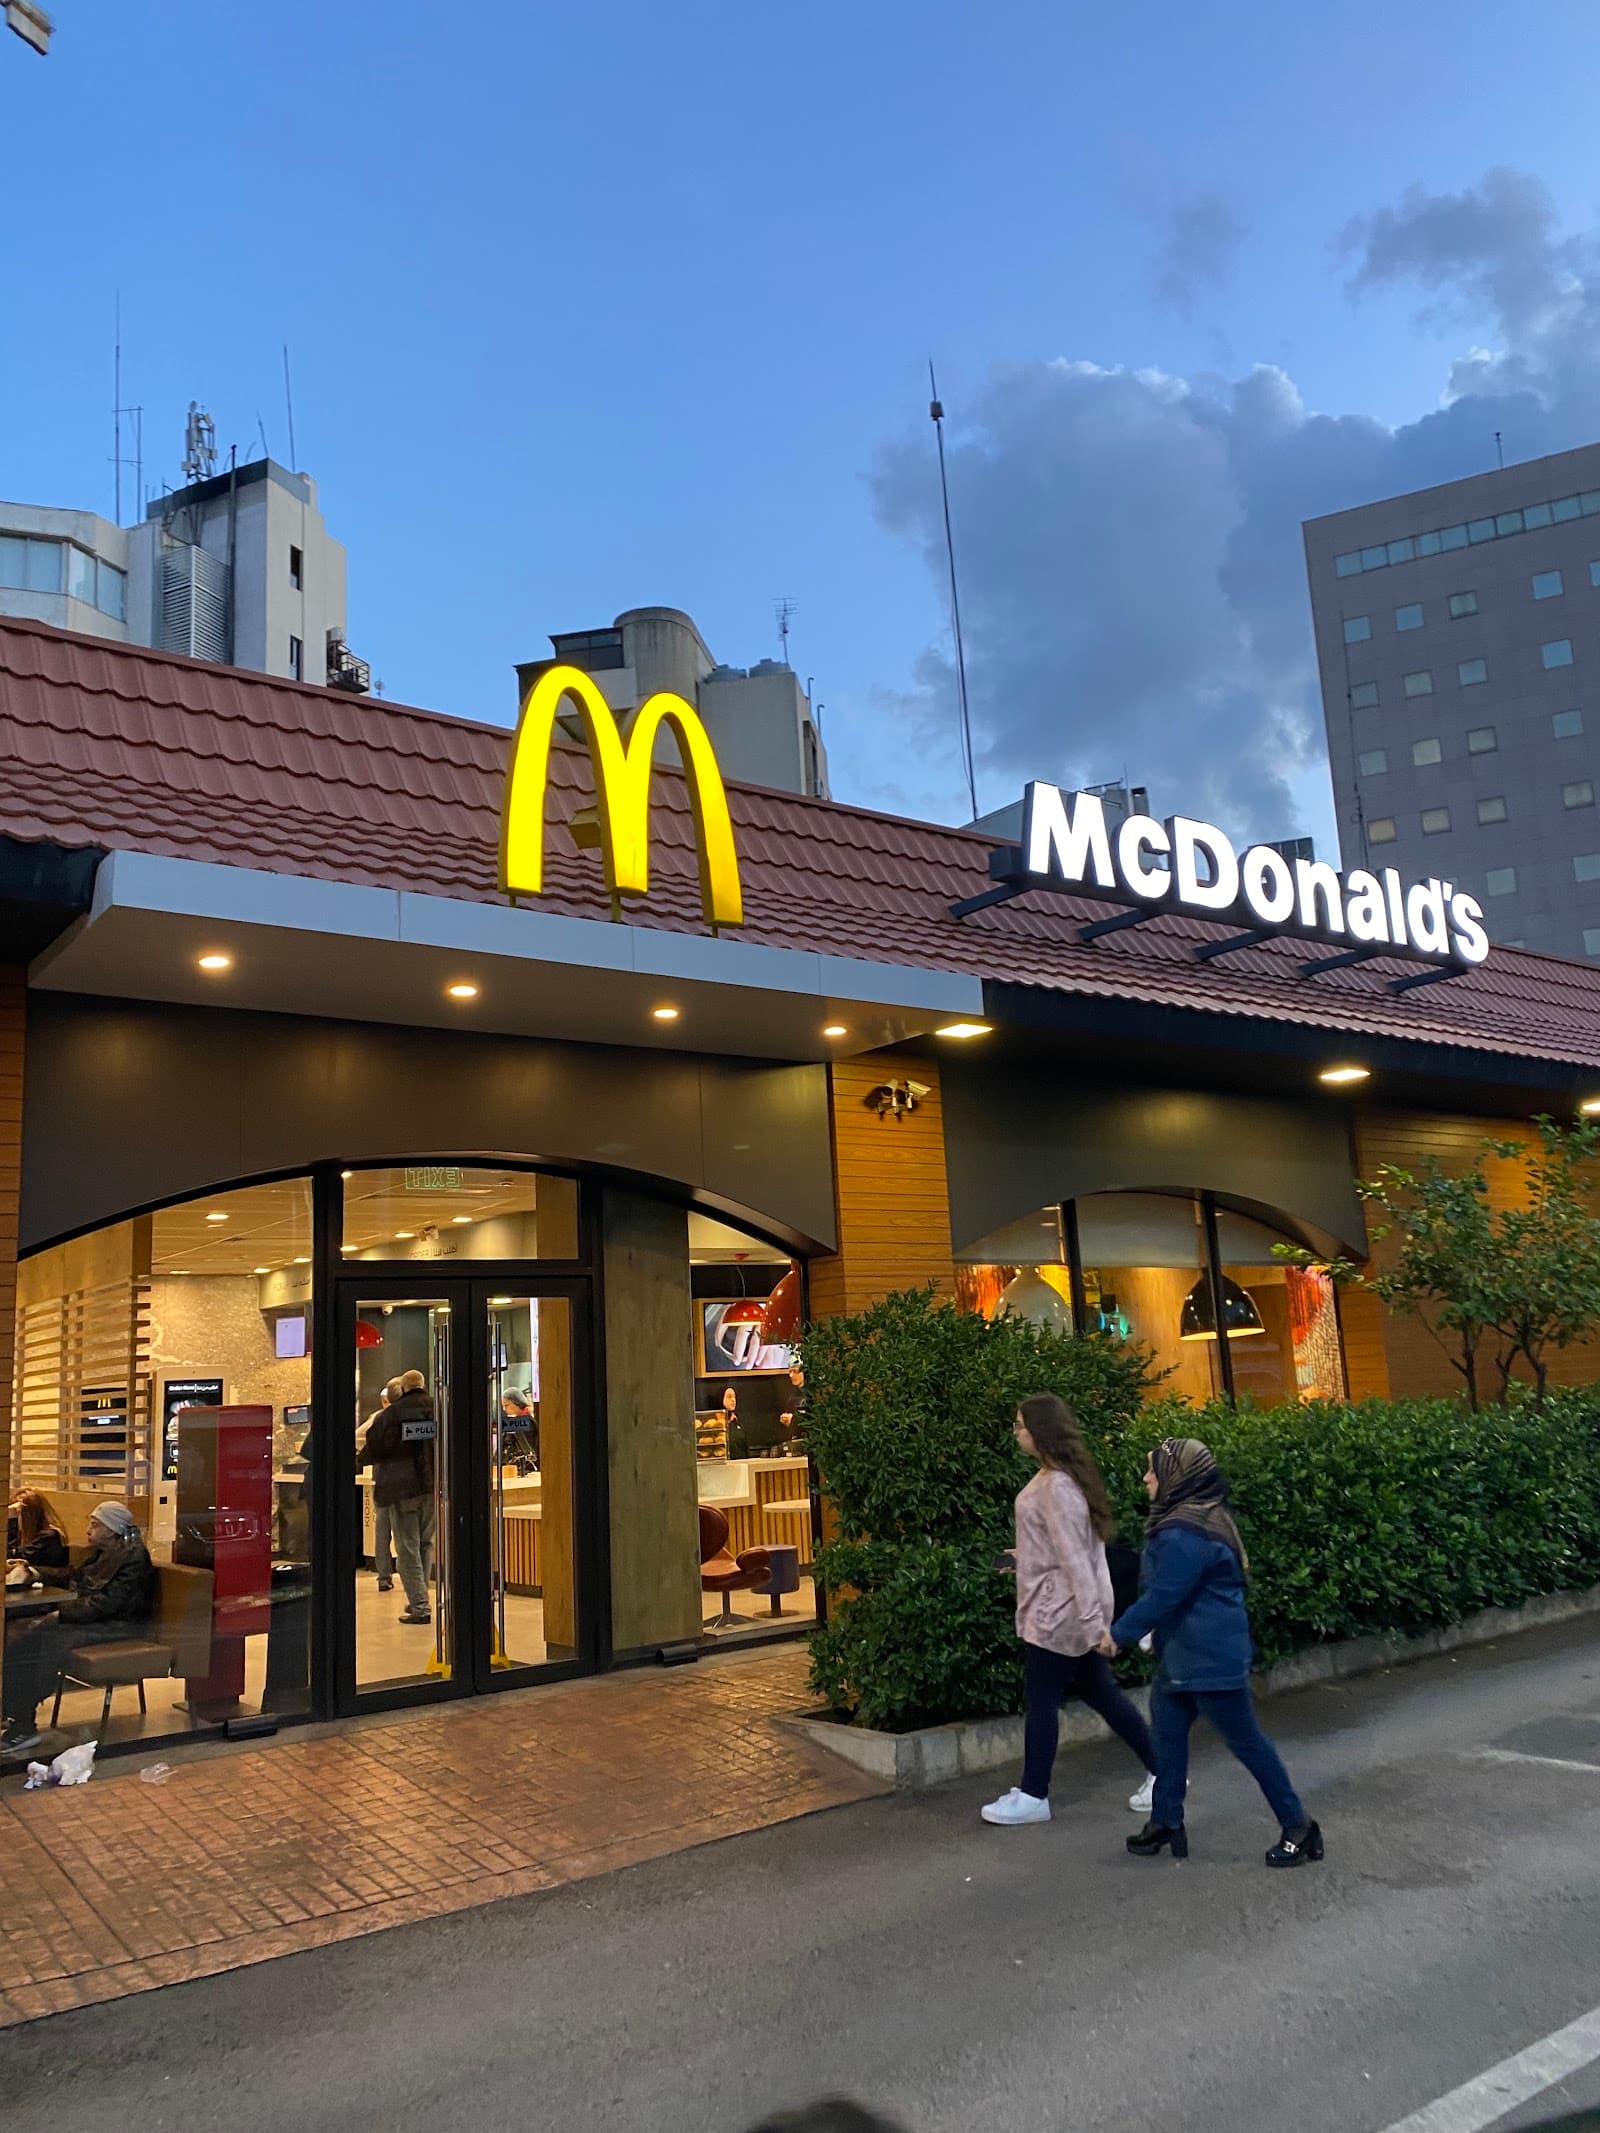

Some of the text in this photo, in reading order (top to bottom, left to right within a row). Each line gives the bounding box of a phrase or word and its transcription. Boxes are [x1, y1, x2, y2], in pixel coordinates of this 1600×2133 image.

[1028, 780, 1490, 963] McDonald's
[509, 1420, 528, 1428] PULL
[415, 1426, 435, 1434] PULL
